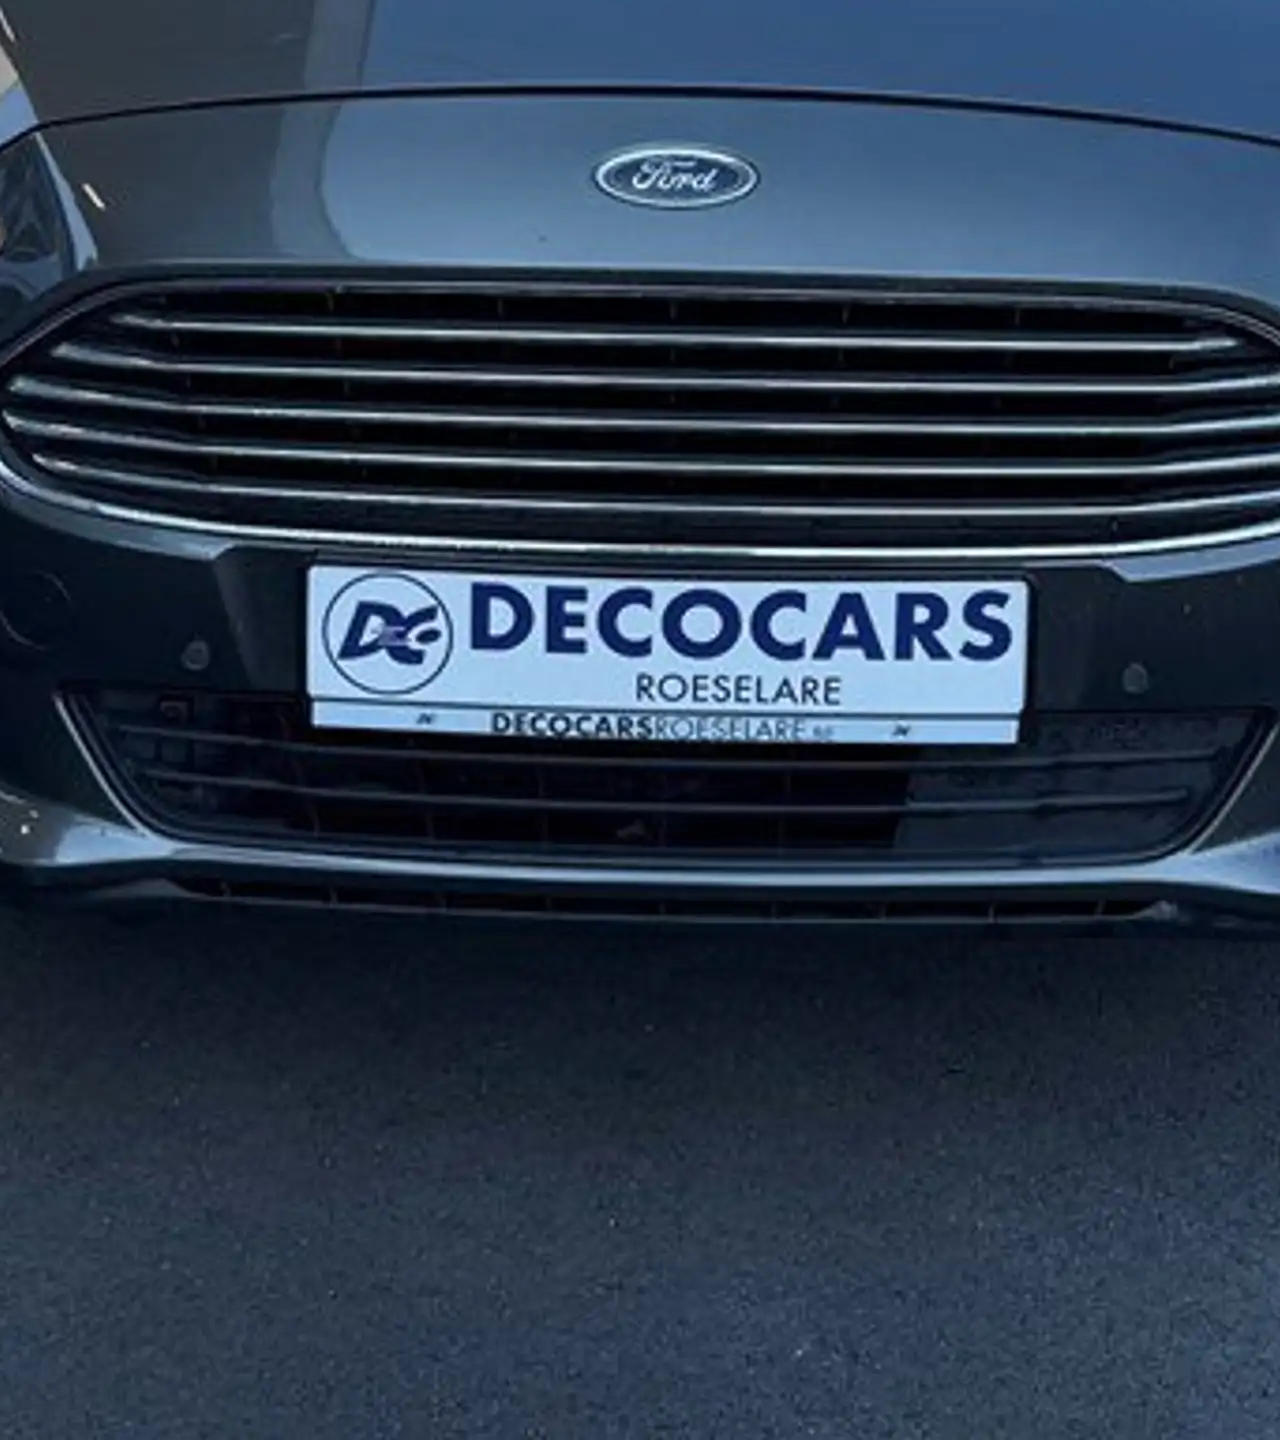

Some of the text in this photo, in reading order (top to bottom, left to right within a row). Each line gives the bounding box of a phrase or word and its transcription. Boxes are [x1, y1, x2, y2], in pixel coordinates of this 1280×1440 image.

[631, 160, 718, 191] Ford
[470, 581, 1013, 662] DECOCARS
[636, 673, 842, 707] ROESELARE
